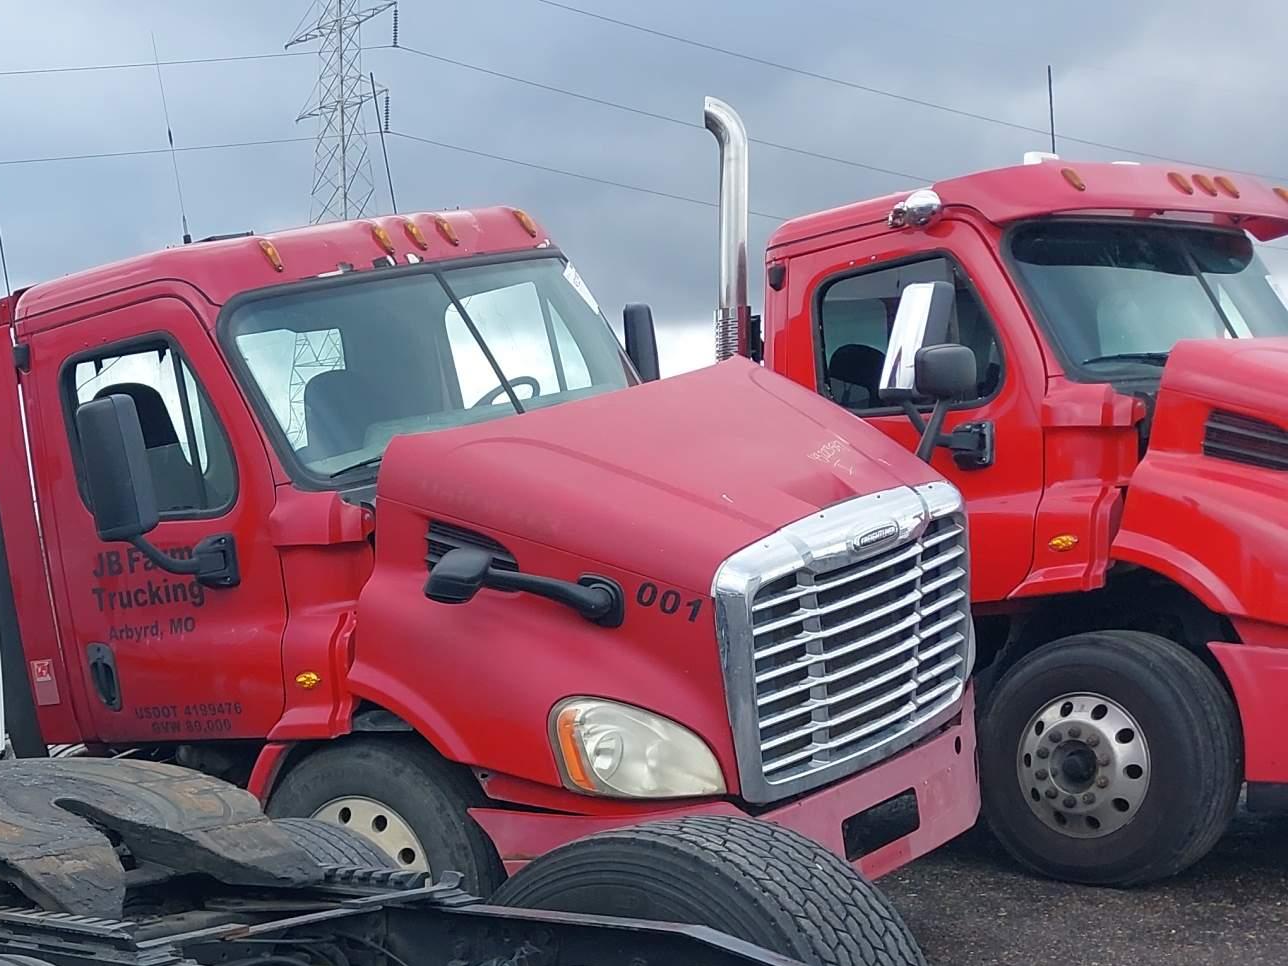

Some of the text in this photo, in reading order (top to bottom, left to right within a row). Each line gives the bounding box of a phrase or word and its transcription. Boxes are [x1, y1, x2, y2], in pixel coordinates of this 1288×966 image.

[92, 551, 124, 579] JB
[92, 578, 206, 612] Trucking
[636, 582, 703, 622] 001
[109, 616, 196, 645] Arbyrd, MO
[135, 705, 177, 719] USDOT
